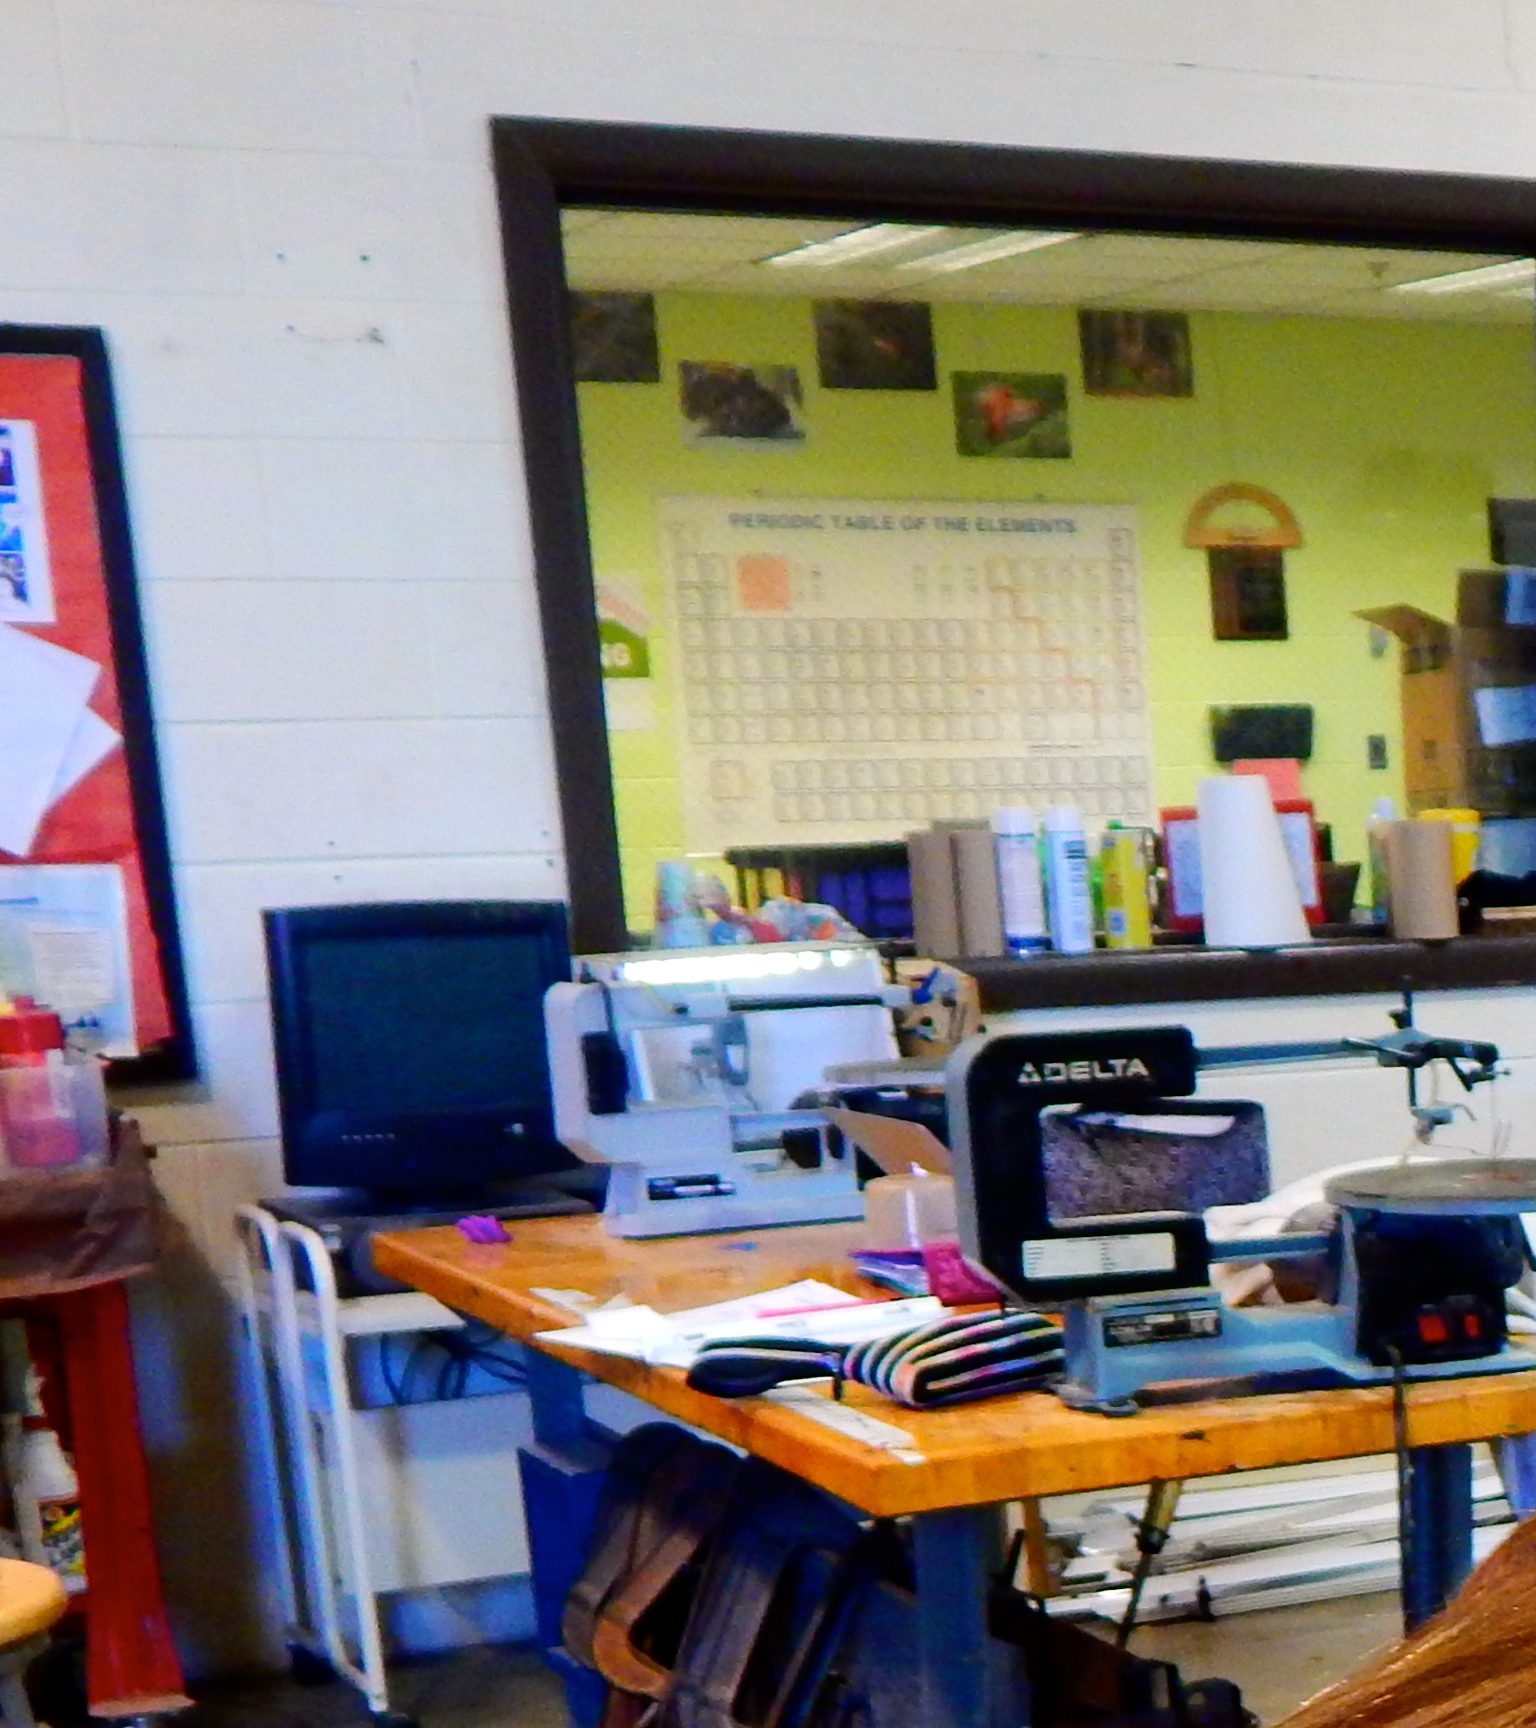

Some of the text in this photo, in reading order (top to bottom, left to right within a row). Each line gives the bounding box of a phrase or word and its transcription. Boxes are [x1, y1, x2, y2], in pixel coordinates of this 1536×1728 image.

[728, 512, 1077, 534] PERIODIC TABLE OF THE ELEMENTS
[1043, 1058, 1150, 1082] DELTA
